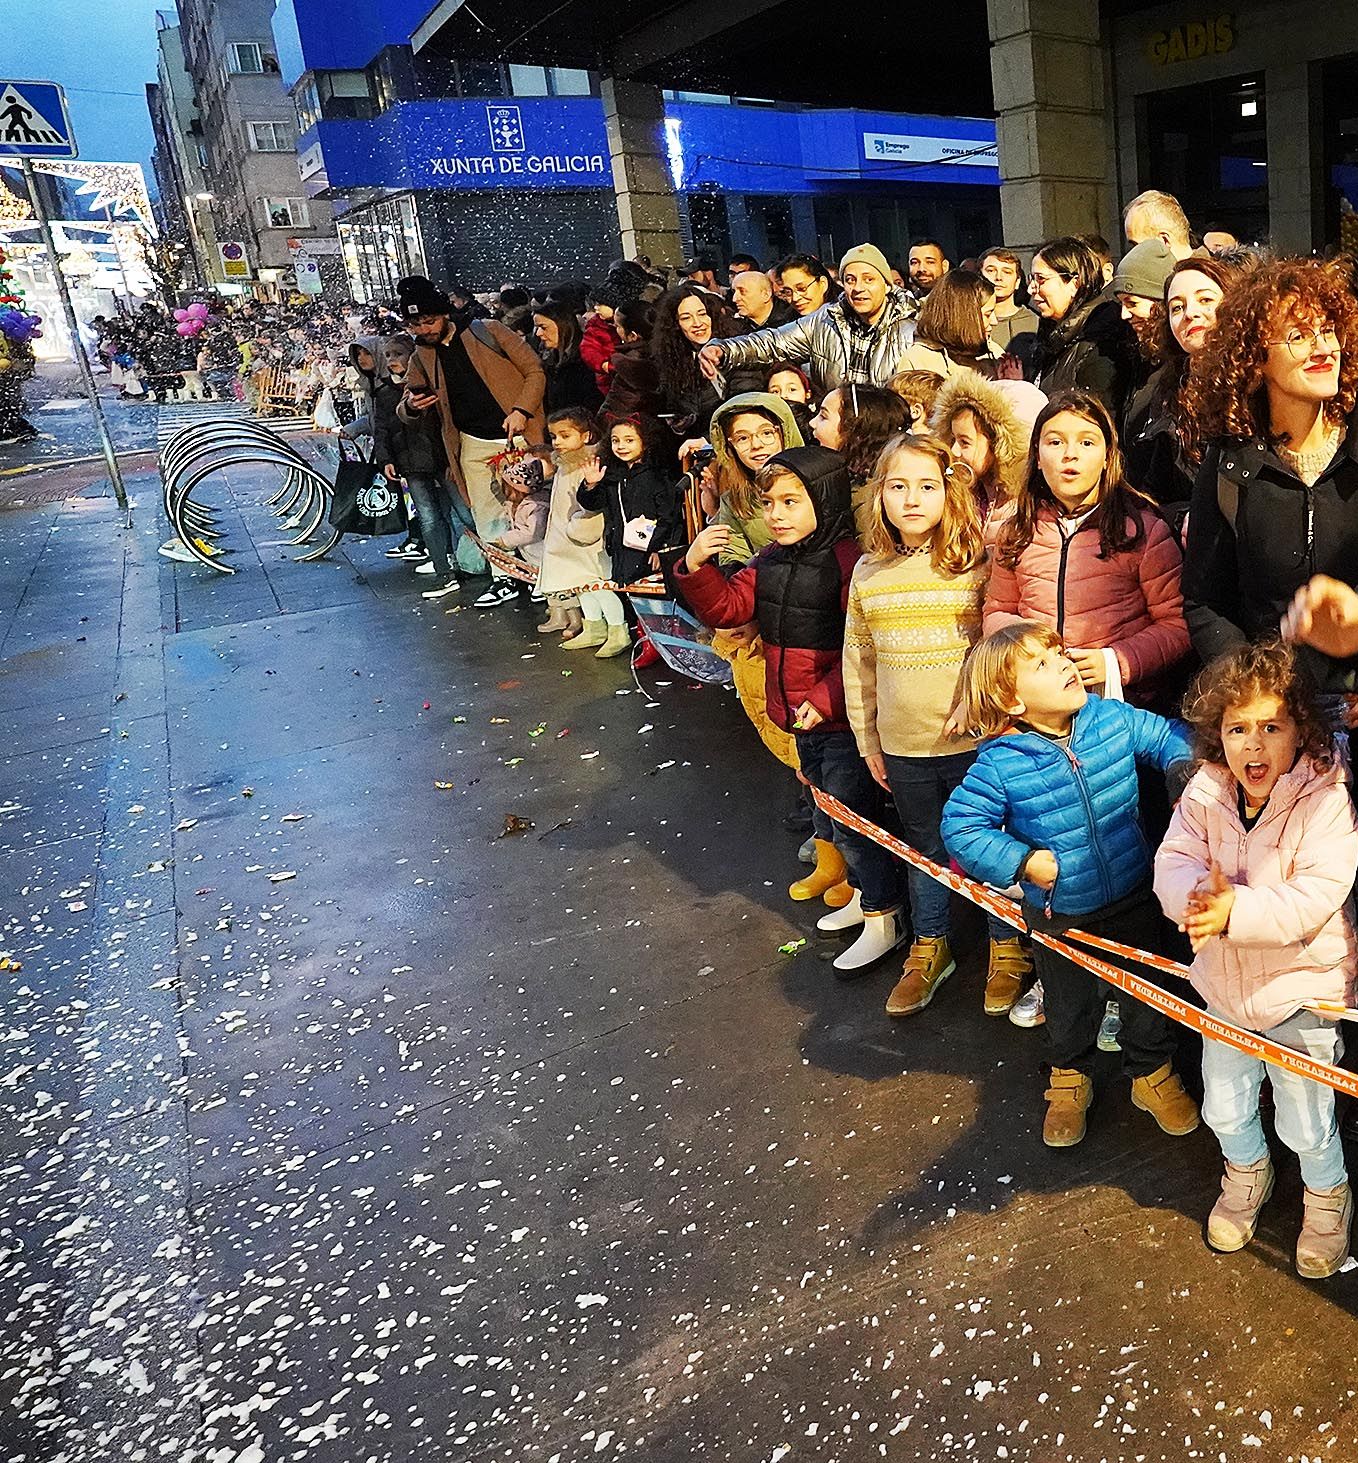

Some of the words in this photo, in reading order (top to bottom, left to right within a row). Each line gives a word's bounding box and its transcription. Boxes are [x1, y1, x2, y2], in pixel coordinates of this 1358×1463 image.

[1147, 14, 1233, 66] GADIS
[941, 147, 965, 155] OFICINA
[430, 156, 494, 175] XUNTA
[499, 156, 524, 173] DE
[527, 155, 604, 173] GALICIA
